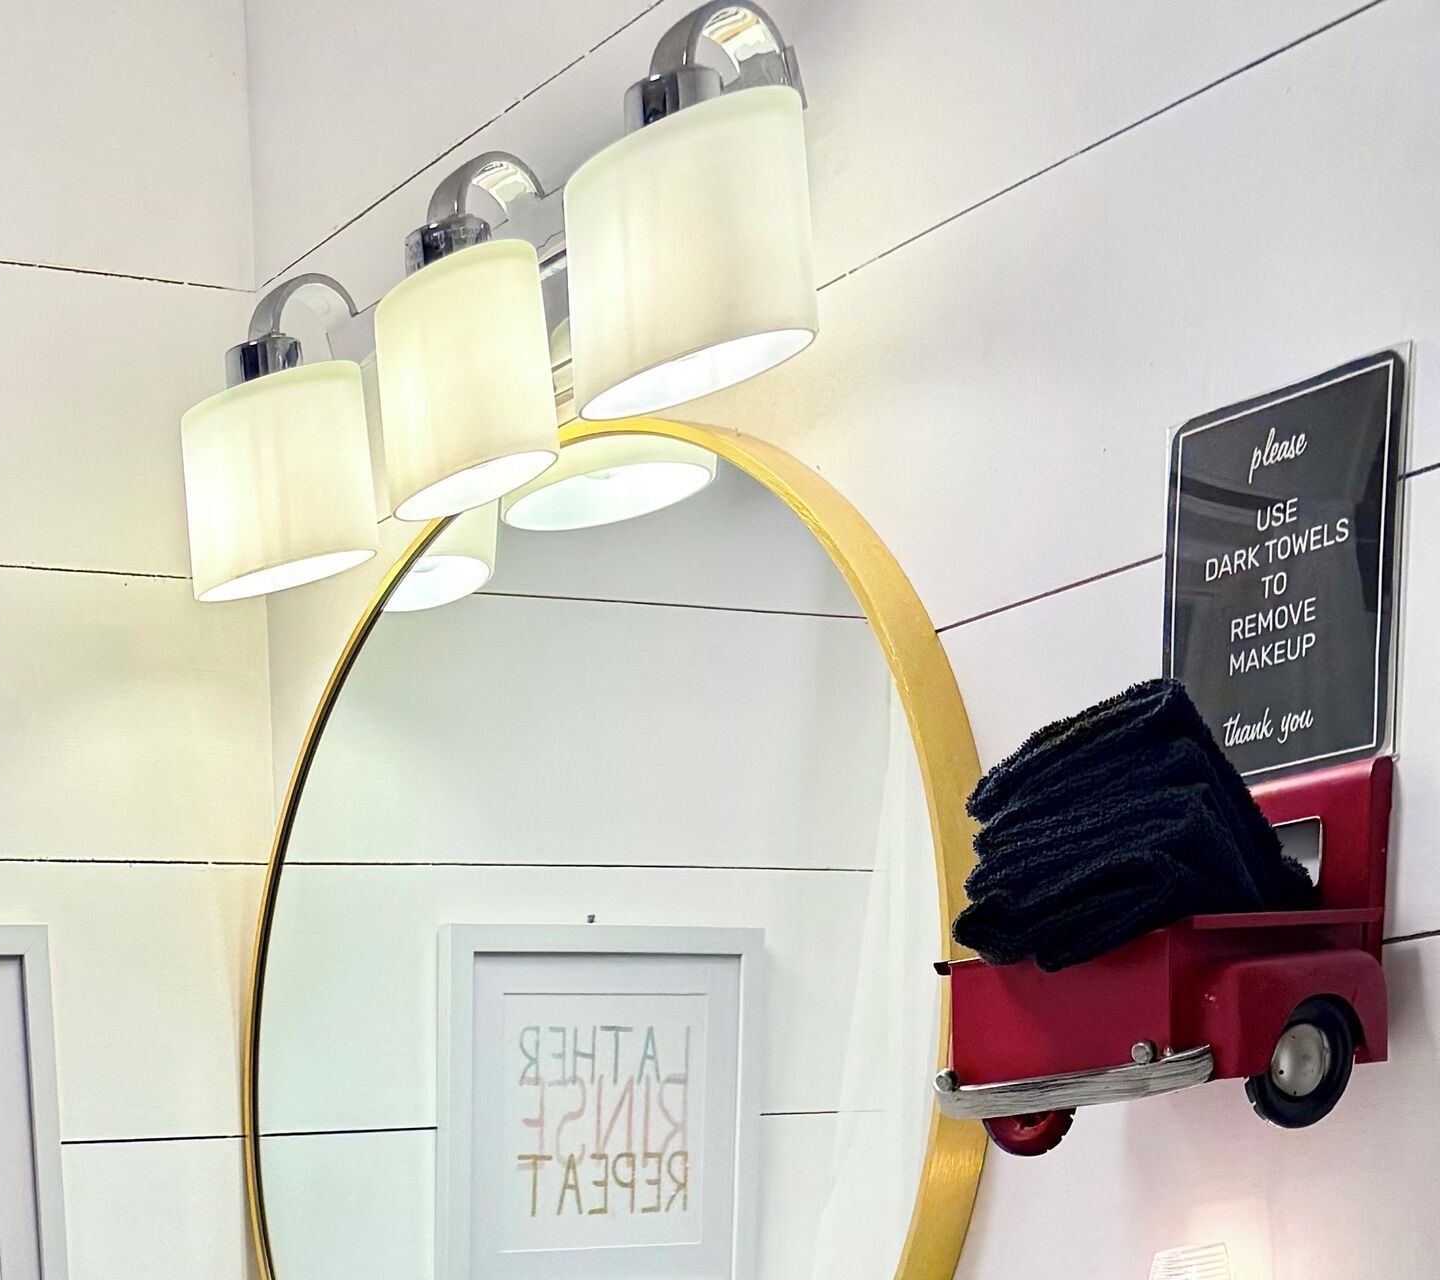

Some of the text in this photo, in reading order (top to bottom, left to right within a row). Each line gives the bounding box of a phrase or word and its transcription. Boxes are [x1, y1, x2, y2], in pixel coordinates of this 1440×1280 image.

[1247, 427, 1307, 485] please
[1256, 497, 1298, 532] USE
[1205, 517, 1350, 581] DARK TOWELS
[1261, 571, 1287, 599] TO
[1230, 597, 1316, 643] REMOVE
[1229, 632, 1316, 676] MAKEUP
[1223, 707, 1314, 747] thank you
